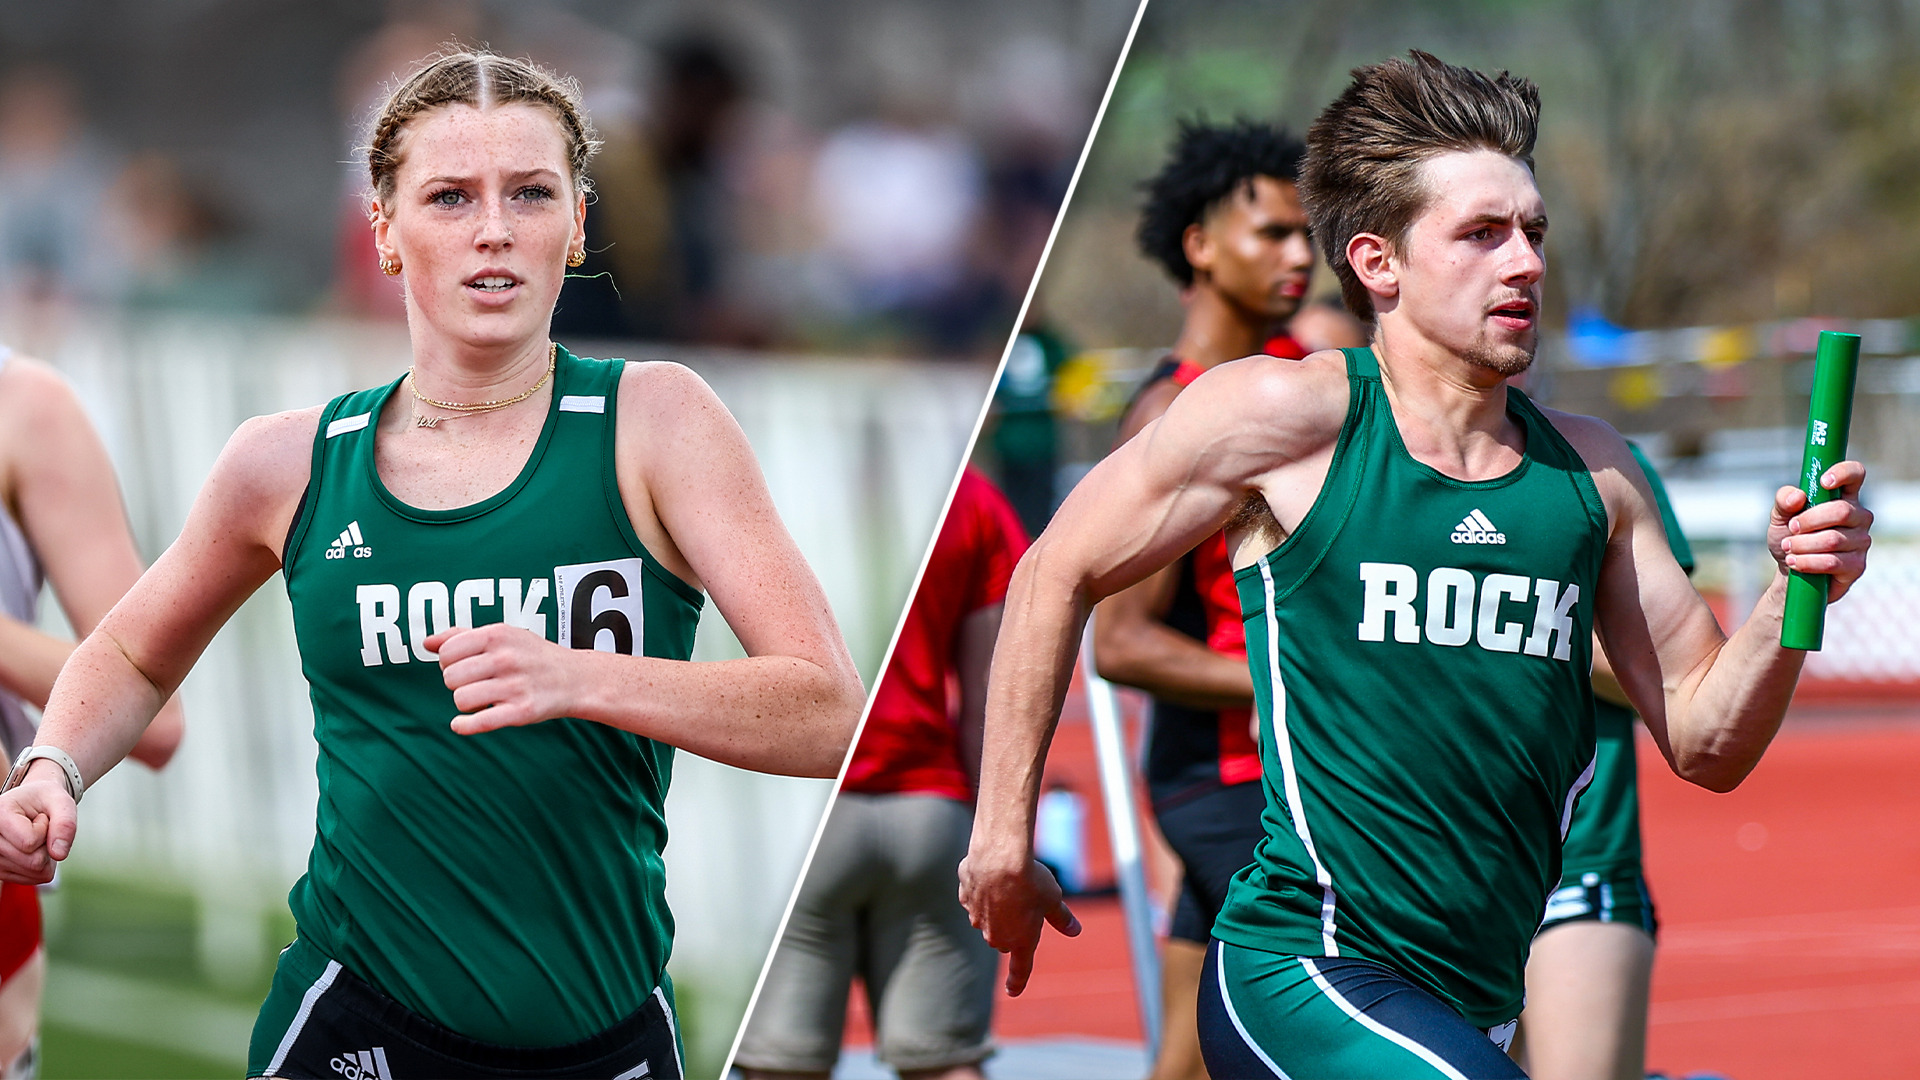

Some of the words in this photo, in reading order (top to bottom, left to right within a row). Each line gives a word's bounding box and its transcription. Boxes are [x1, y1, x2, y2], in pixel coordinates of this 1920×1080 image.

[325, 546, 373, 560] adias
[1450, 530, 1507, 545] adidas
[356, 578, 549, 667] ROCK
[571, 569, 634, 656] 6
[1358, 562, 1580, 662] ROCK
[330, 1057, 381, 1080] adi
